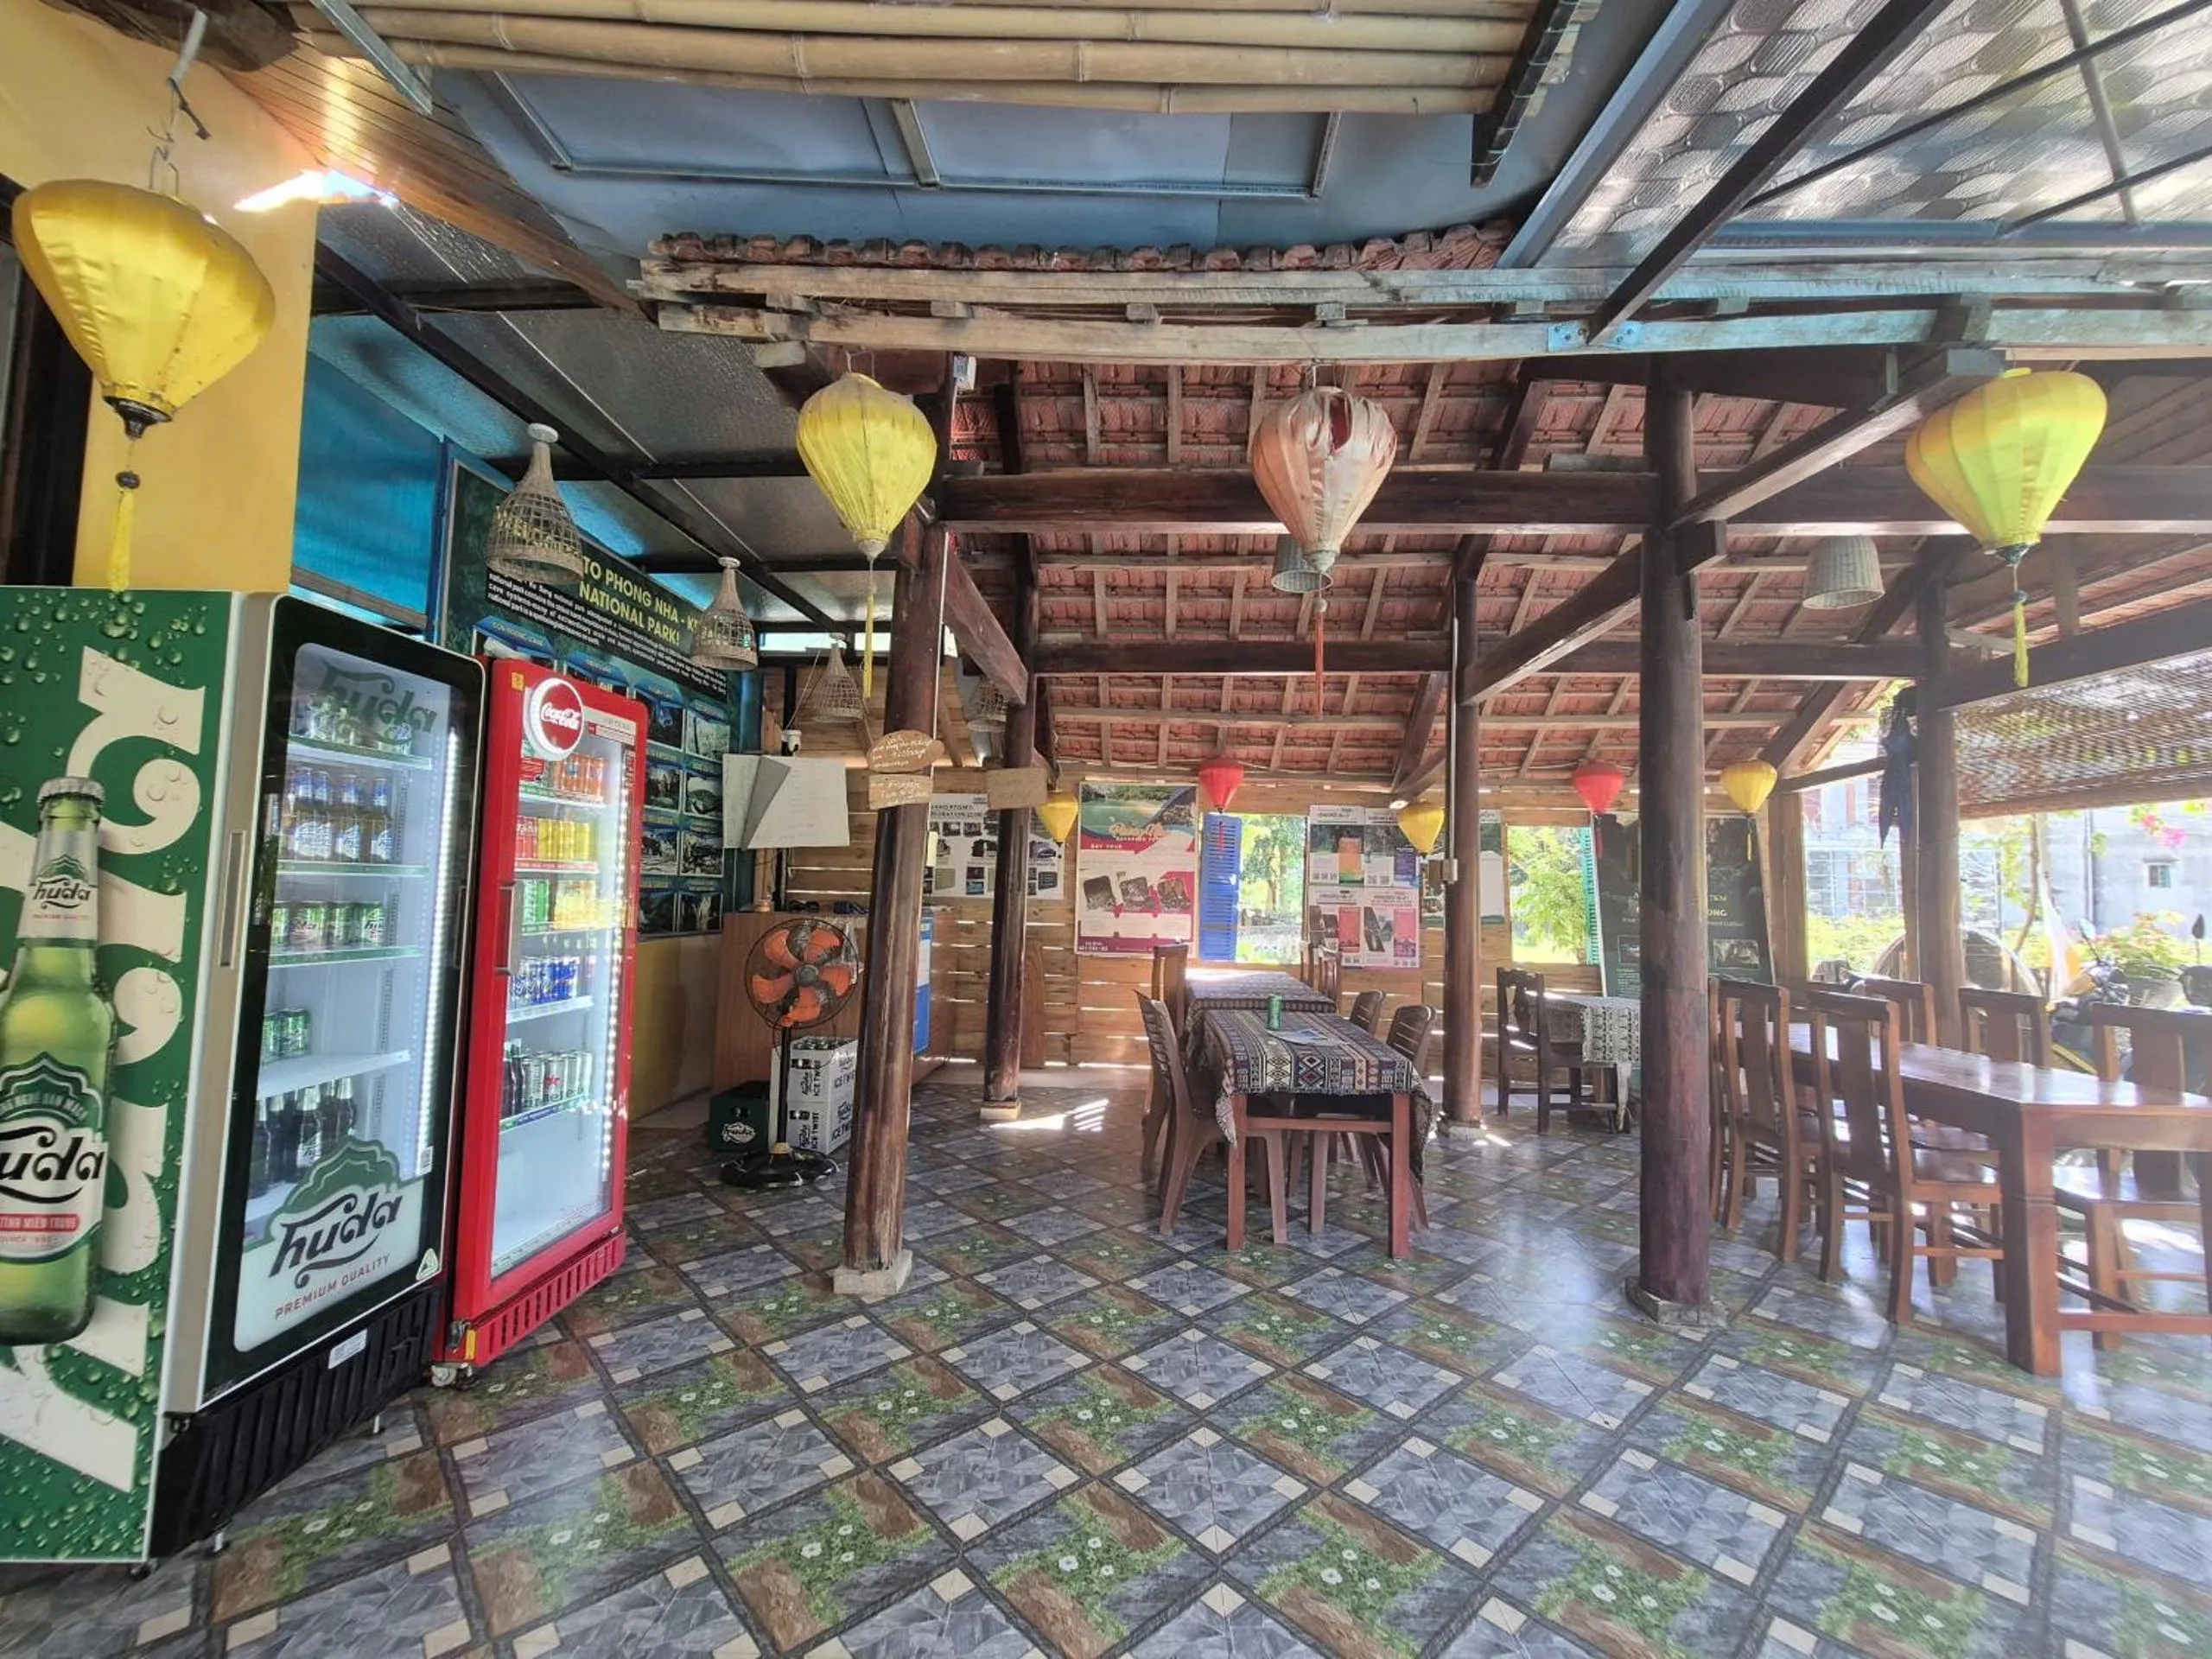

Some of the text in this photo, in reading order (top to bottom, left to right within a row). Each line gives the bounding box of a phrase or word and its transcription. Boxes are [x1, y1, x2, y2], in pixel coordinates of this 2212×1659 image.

[578, 580, 645, 629] NATIONAL
[647, 615, 680, 646] PARK!
[583, 556, 601, 580] TO
[606, 570, 652, 607] PHONG
[654, 596, 679, 623] NHA
[540, 701, 581, 731] Coca-Cola
[33, 876, 92, 909] huda
[0, 1126, 105, 1204] uda
[810, 1135, 819, 1149] ICE
[268, 1192, 404, 1289] huda
[274, 1253, 391, 1320] PREMIUM QUALITY
